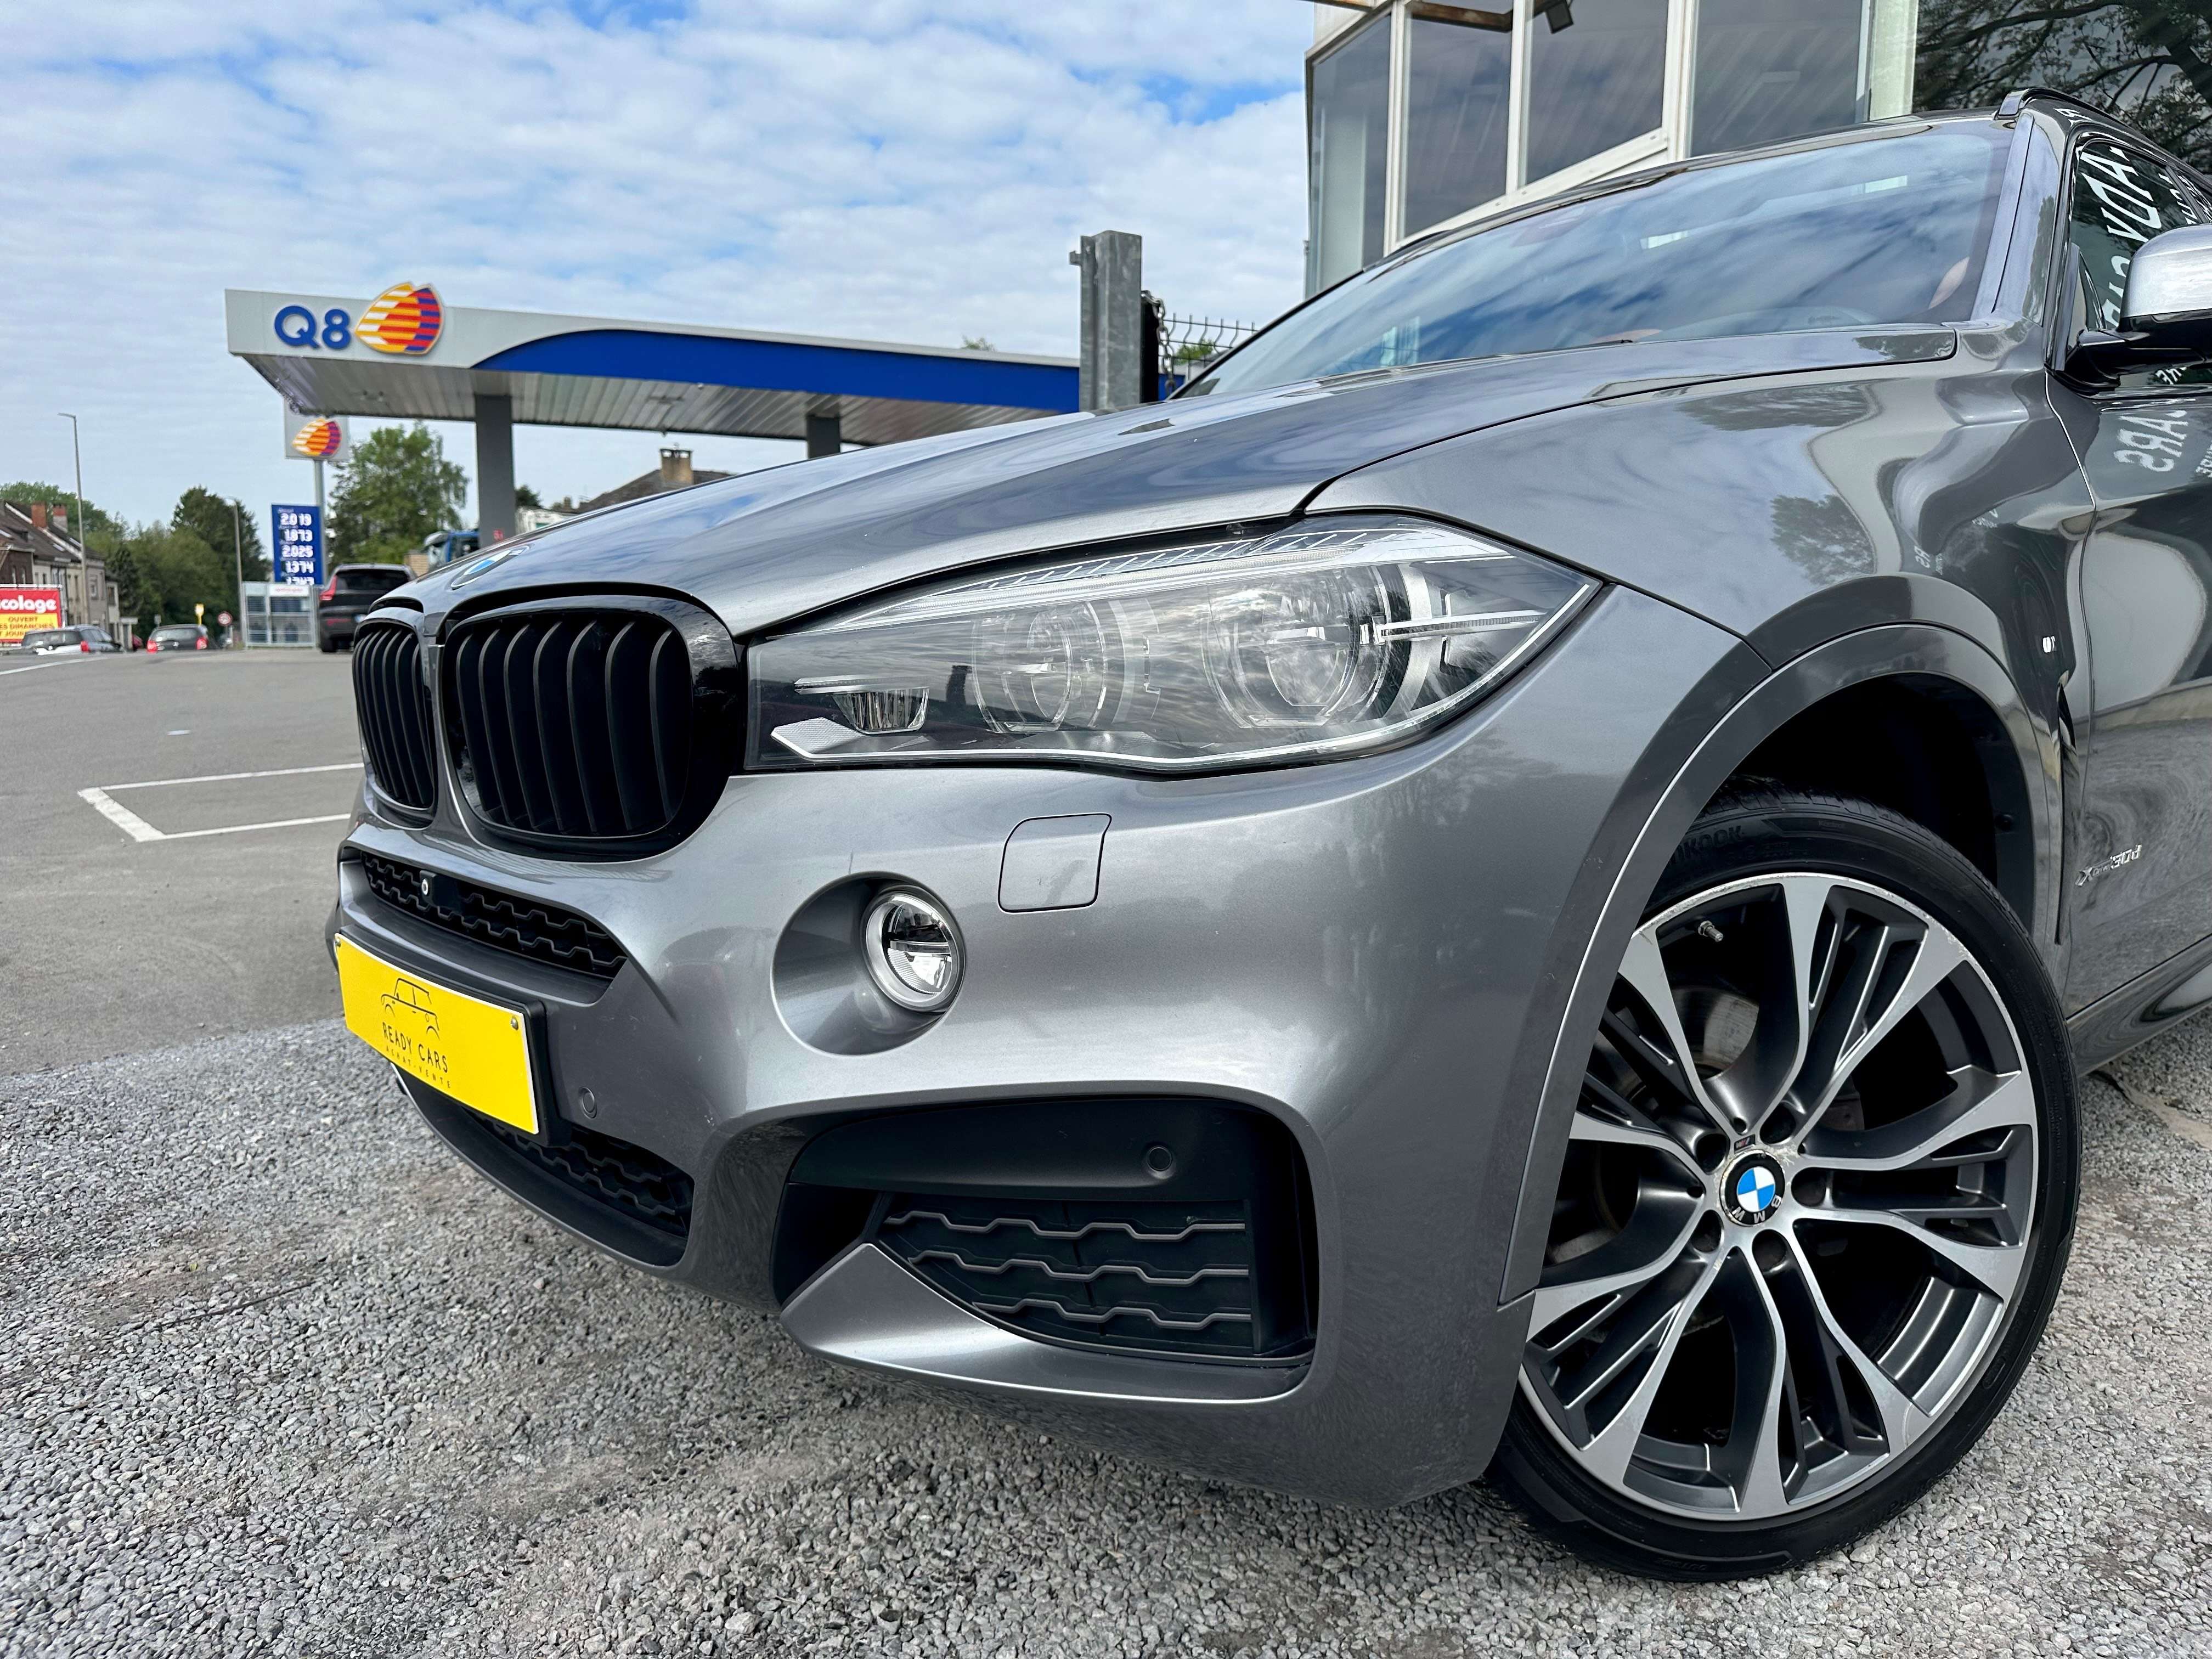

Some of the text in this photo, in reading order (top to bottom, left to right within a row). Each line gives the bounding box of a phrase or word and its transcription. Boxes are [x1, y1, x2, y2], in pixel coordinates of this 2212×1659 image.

[274, 306, 351, 349] Q8
[0, 595, 57, 614] colage
[382, 1022, 448, 1073] READY CARS
[1731, 1194, 1782, 1224] BMW
